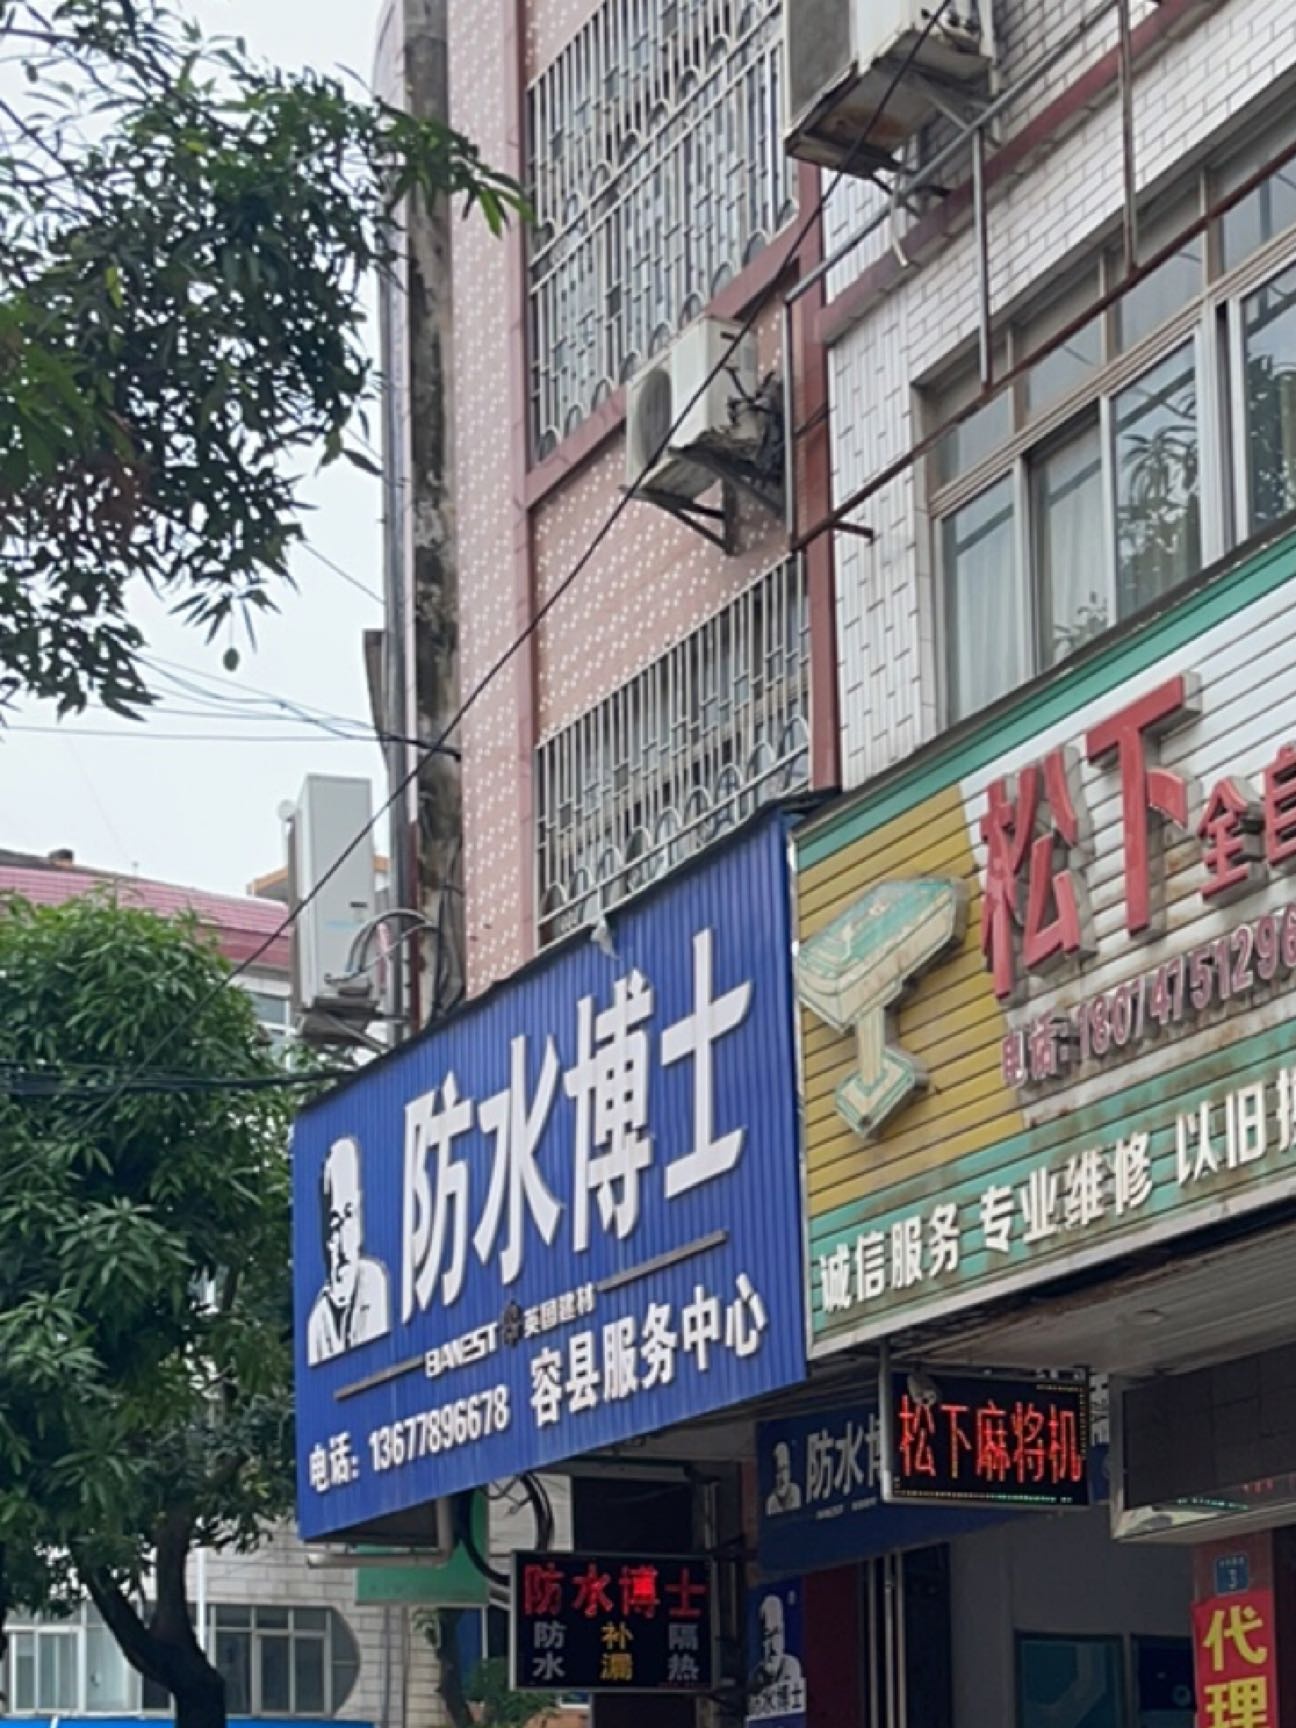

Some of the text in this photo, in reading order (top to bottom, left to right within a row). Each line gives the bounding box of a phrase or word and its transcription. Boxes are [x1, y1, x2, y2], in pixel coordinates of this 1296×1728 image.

[978, 673, 1192, 998] 松下
[401, 928, 753, 1326] 防水博士
[818, 1203, 961, 1312] 诚信服务
[978, 1135, 1154, 1254] 专业维修
[368, 1384, 510, 1472] 13677896678
[530, 1272, 767, 1428] 容县服务中心
[899, 1393, 1082, 1485] 松下麻将机
[523, 1562, 707, 1618] 防水博士
[532, 1620, 567, 1681] 防水
